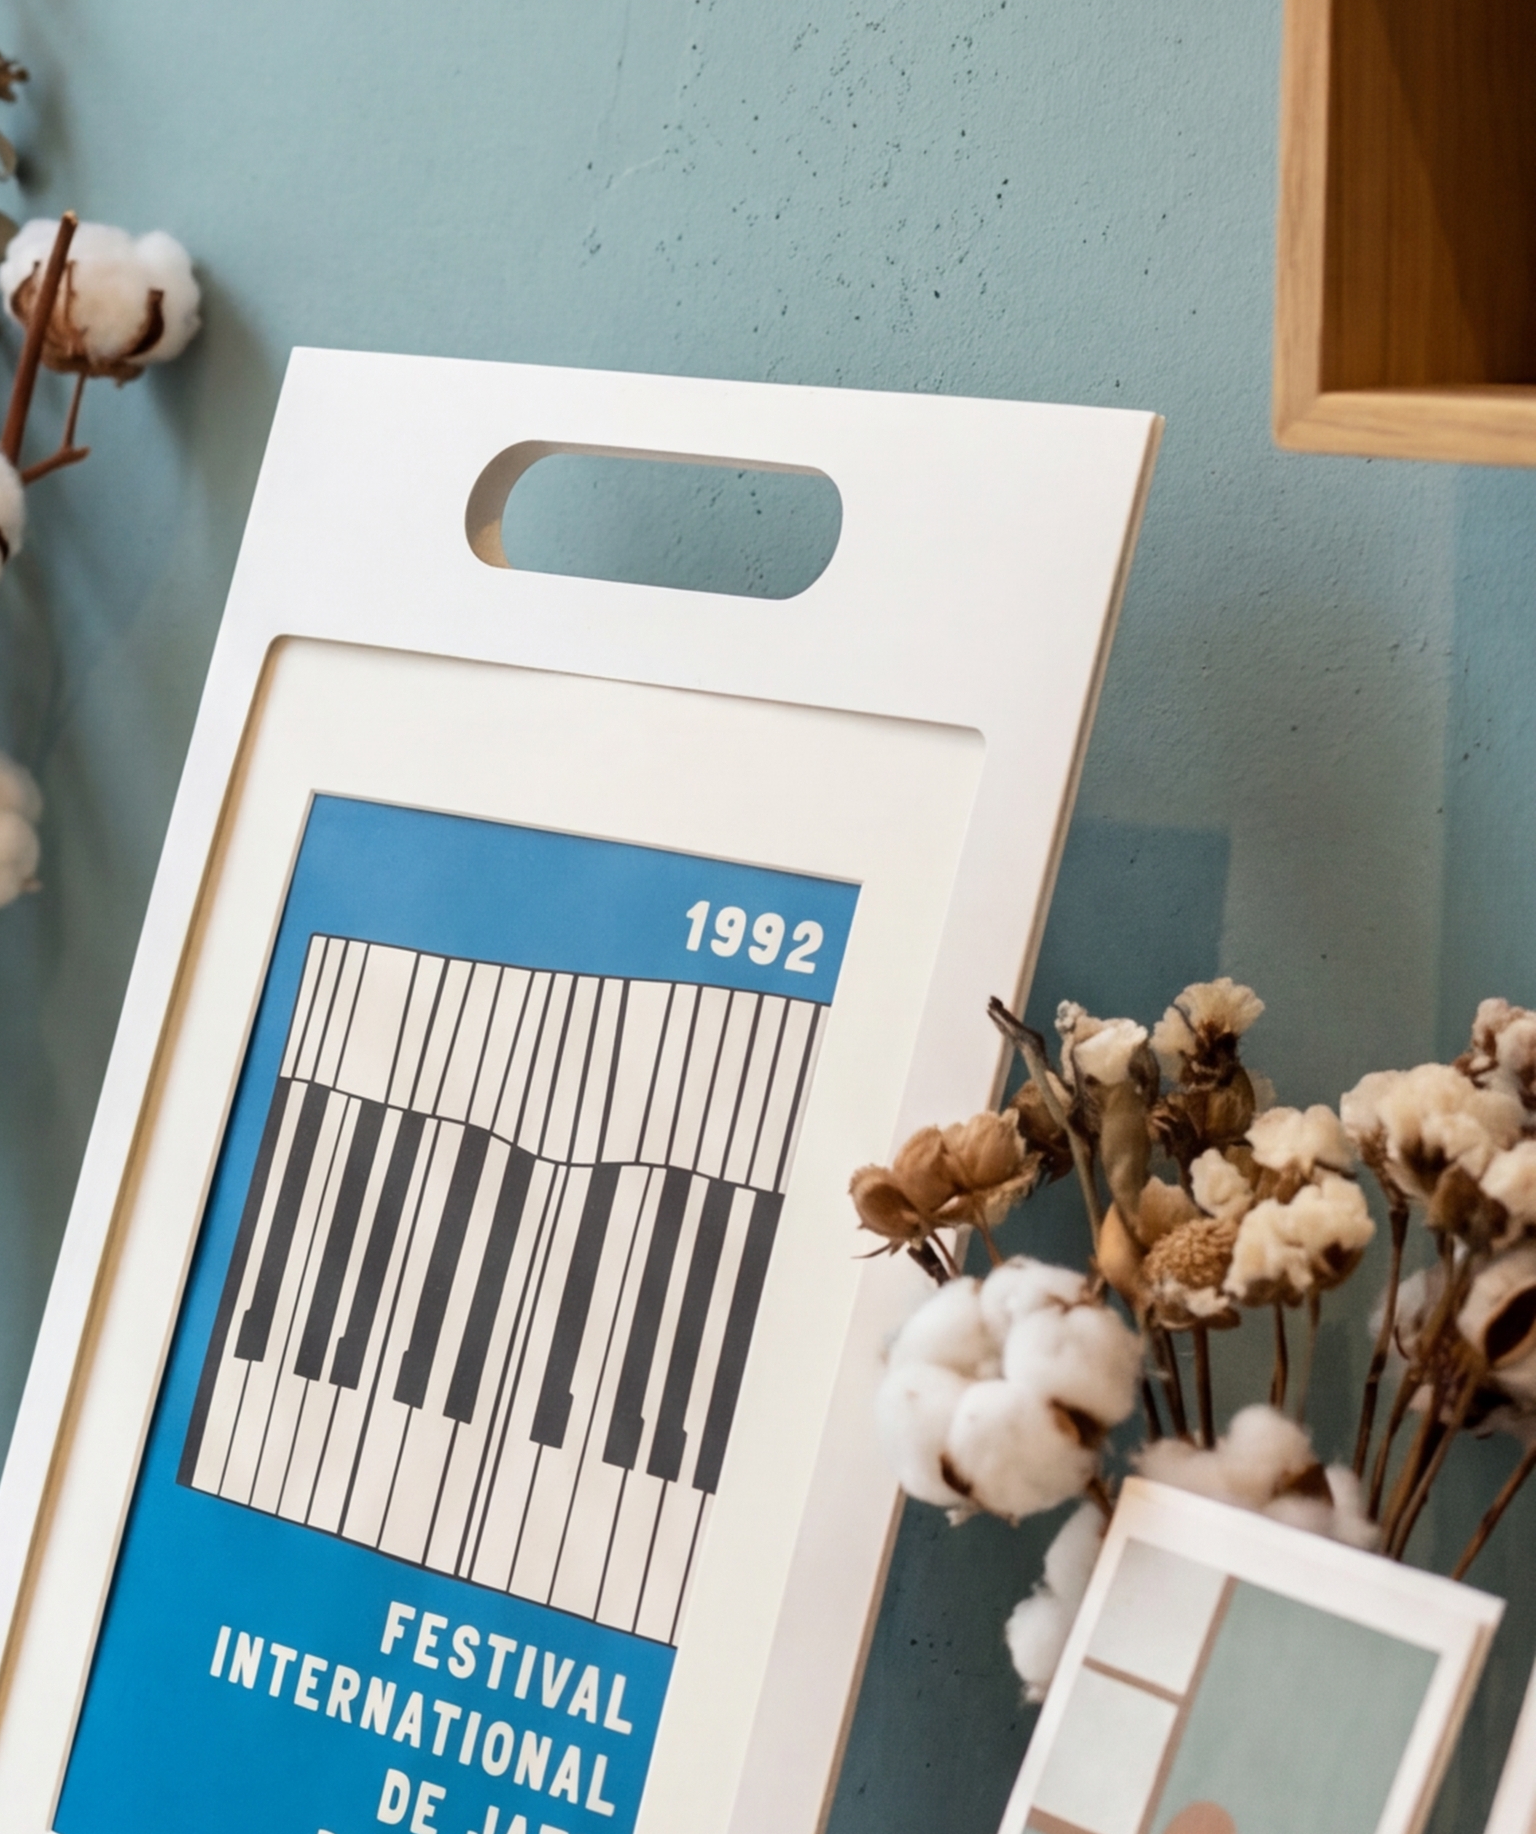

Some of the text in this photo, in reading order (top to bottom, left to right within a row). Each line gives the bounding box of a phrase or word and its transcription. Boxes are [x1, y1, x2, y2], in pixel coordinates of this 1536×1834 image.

[685, 900, 824, 975] 1992
[210, 1625, 615, 1817] INTERNATIONAL
[380, 1601, 633, 1735] FESTIVAL
